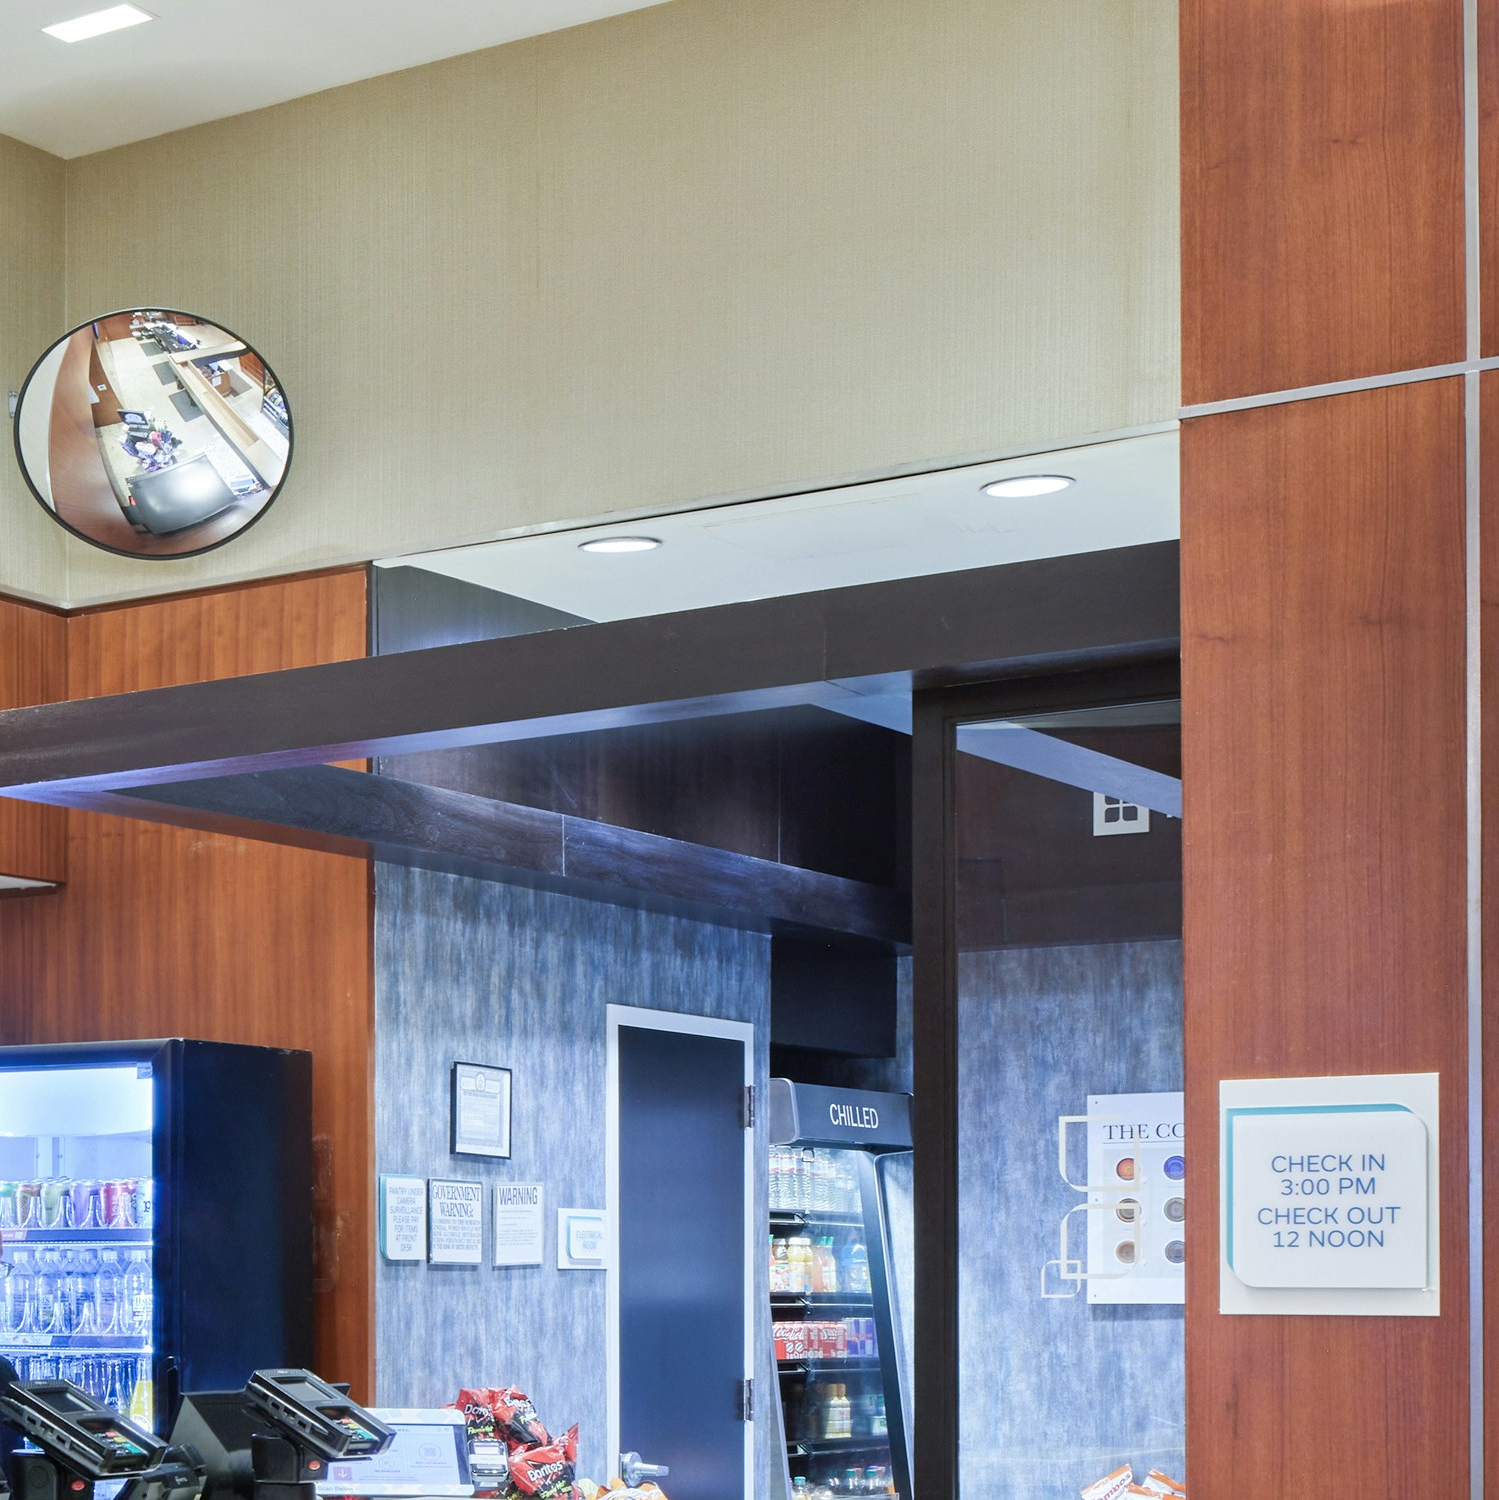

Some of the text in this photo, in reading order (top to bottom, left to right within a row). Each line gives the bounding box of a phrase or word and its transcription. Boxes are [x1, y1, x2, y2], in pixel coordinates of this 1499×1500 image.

[829, 1103, 879, 1129] CHILLED
[1102, 1123, 1150, 1140] THE
[1271, 1154, 1385, 1173] CHECK IN
[433, 1184, 481, 1201] GOVERNMENT
[1281, 1177, 1376, 1196] 3:00 PM
[499, 1187, 538, 1205] WARNING
[1257, 1207, 1401, 1225] CHECK OUT
[1273, 1230, 1384, 1248] 12 NOON
[527, 1460, 563, 1482] Doritos
